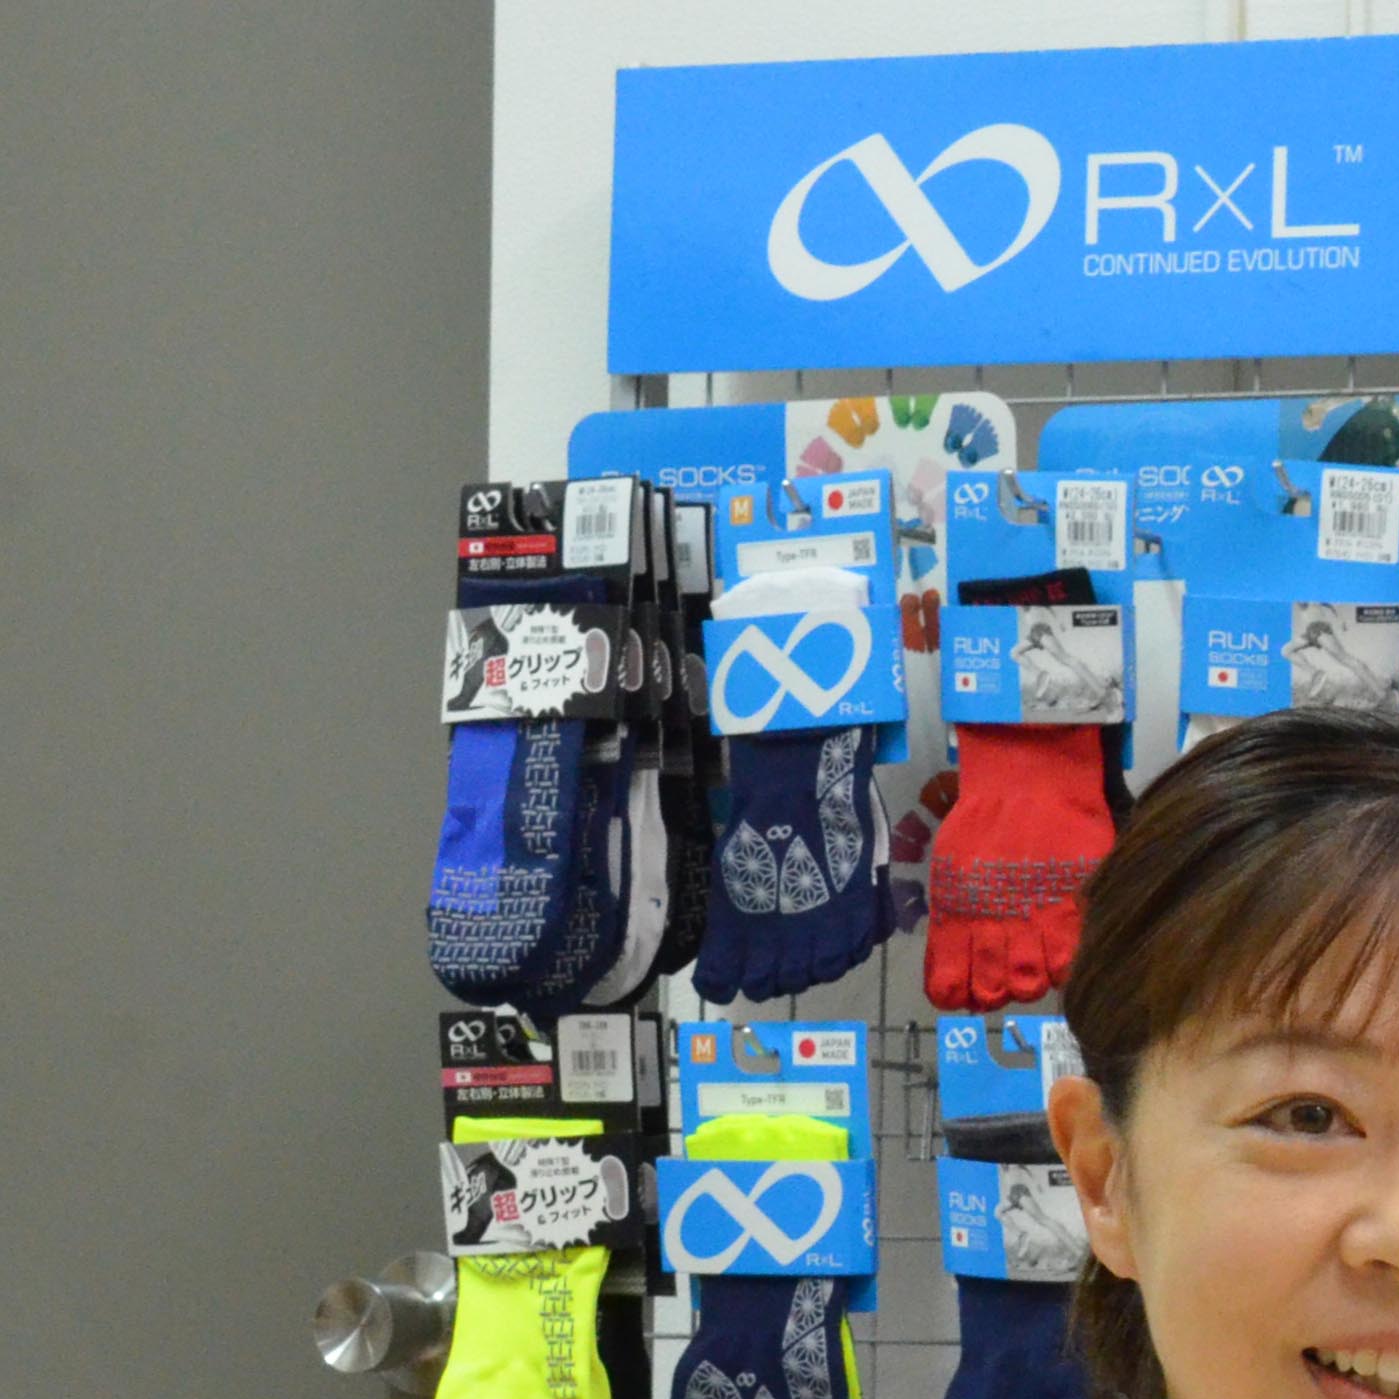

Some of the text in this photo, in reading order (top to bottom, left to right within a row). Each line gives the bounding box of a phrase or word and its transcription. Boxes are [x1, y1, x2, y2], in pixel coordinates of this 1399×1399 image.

[1083, 244, 1361, 277] CONTINUED EVOLUTION
[659, 464, 757, 488] SOCKS
[848, 486, 877, 499] JAPAN
[732, 497, 751, 517] M
[848, 498, 875, 510] MADE
[954, 637, 1000, 655] RUN
[1208, 631, 1270, 651] RUN
[954, 657, 1001, 670] SOCKS
[1208, 652, 1270, 666] SOCKS
[532, 674, 571, 690] フィット
[696, 1041, 713, 1059] M
[820, 1037, 851, 1050] JAPAN
[821, 1048, 849, 1060] MADE
[949, 1191, 988, 1213] RUN
[550, 1205, 592, 1223] フィット
[950, 1212, 988, 1227] SOCKS
